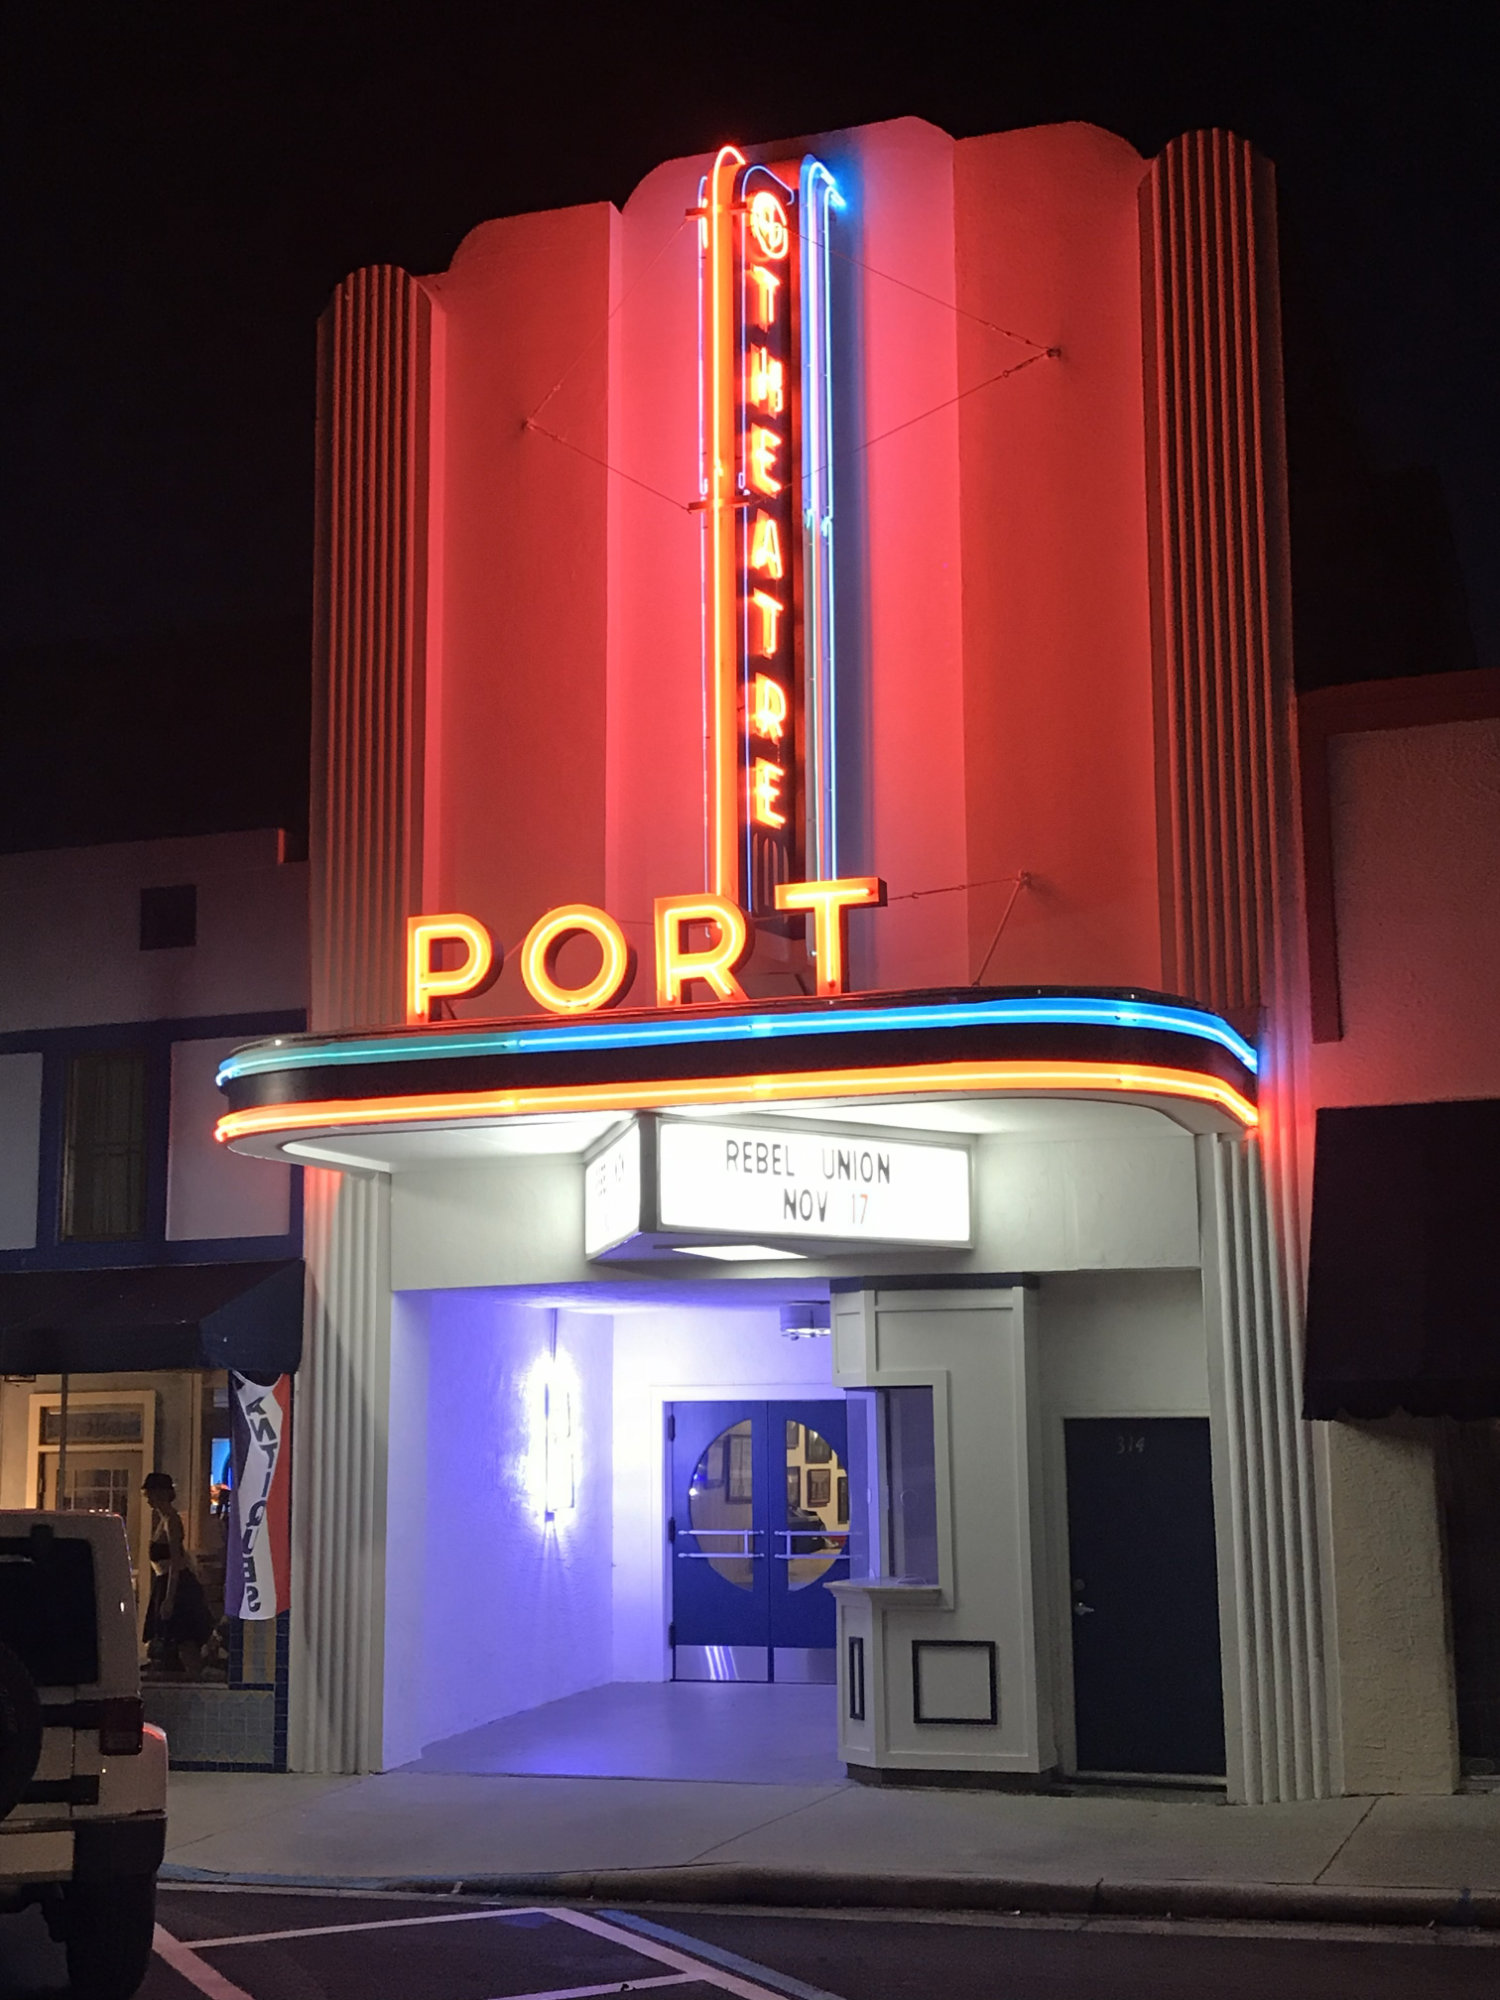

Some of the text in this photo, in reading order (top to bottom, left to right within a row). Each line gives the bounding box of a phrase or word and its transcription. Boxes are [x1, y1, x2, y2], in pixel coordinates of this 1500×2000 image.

[749, 264, 786, 829] THEATRE
[407, 877, 884, 1025] PORT
[726, 1139, 891, 1184] REBEL UNION
[783, 1188, 869, 1225] NOV 17
[1117, 1435, 1146, 1454] 314
